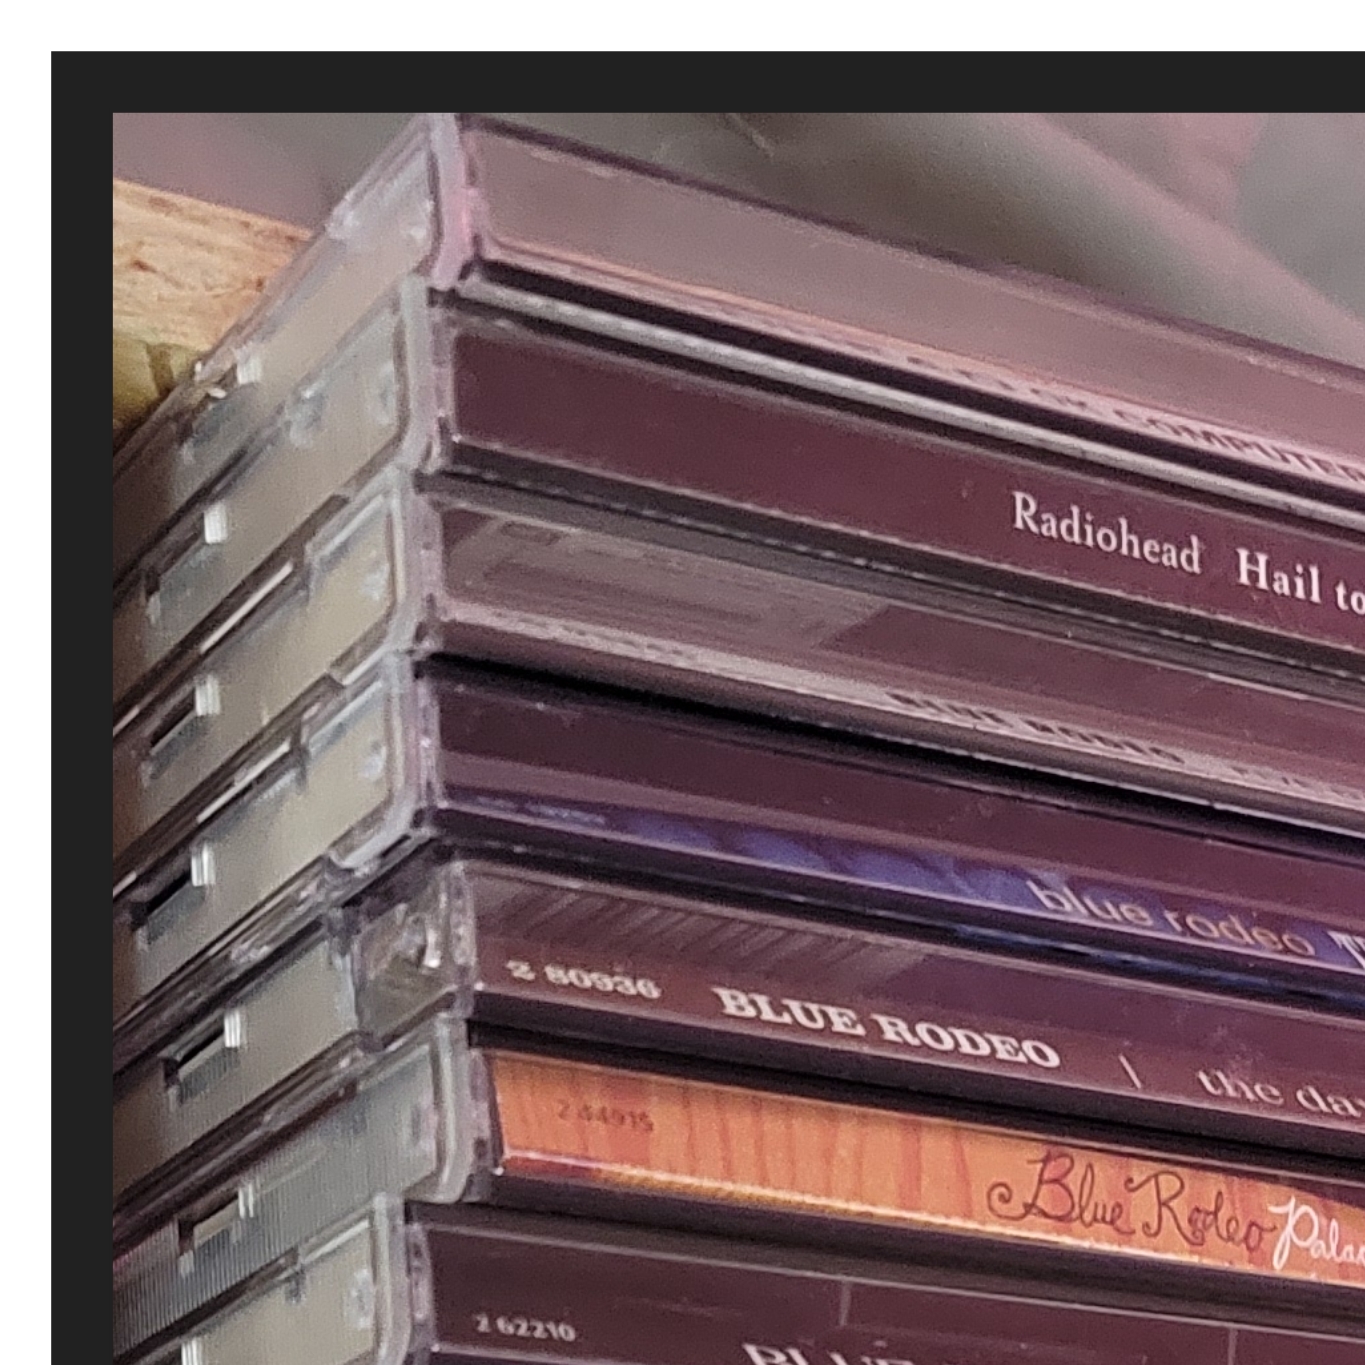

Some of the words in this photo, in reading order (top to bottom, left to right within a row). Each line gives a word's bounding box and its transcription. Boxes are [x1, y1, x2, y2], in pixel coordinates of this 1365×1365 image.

[1012, 491, 1201, 575] Radiohead
[1235, 547, 1322, 604] Hail
[1026, 879, 1154, 926] blue
[1165, 911, 1316, 958] rodeo
[506, 959, 537, 982] 2
[711, 986, 867, 1037] BLUE
[871, 1012, 1063, 1070] RODEO
[1197, 1068, 1284, 1107] the
[495, 1316, 577, 1342] 62210
